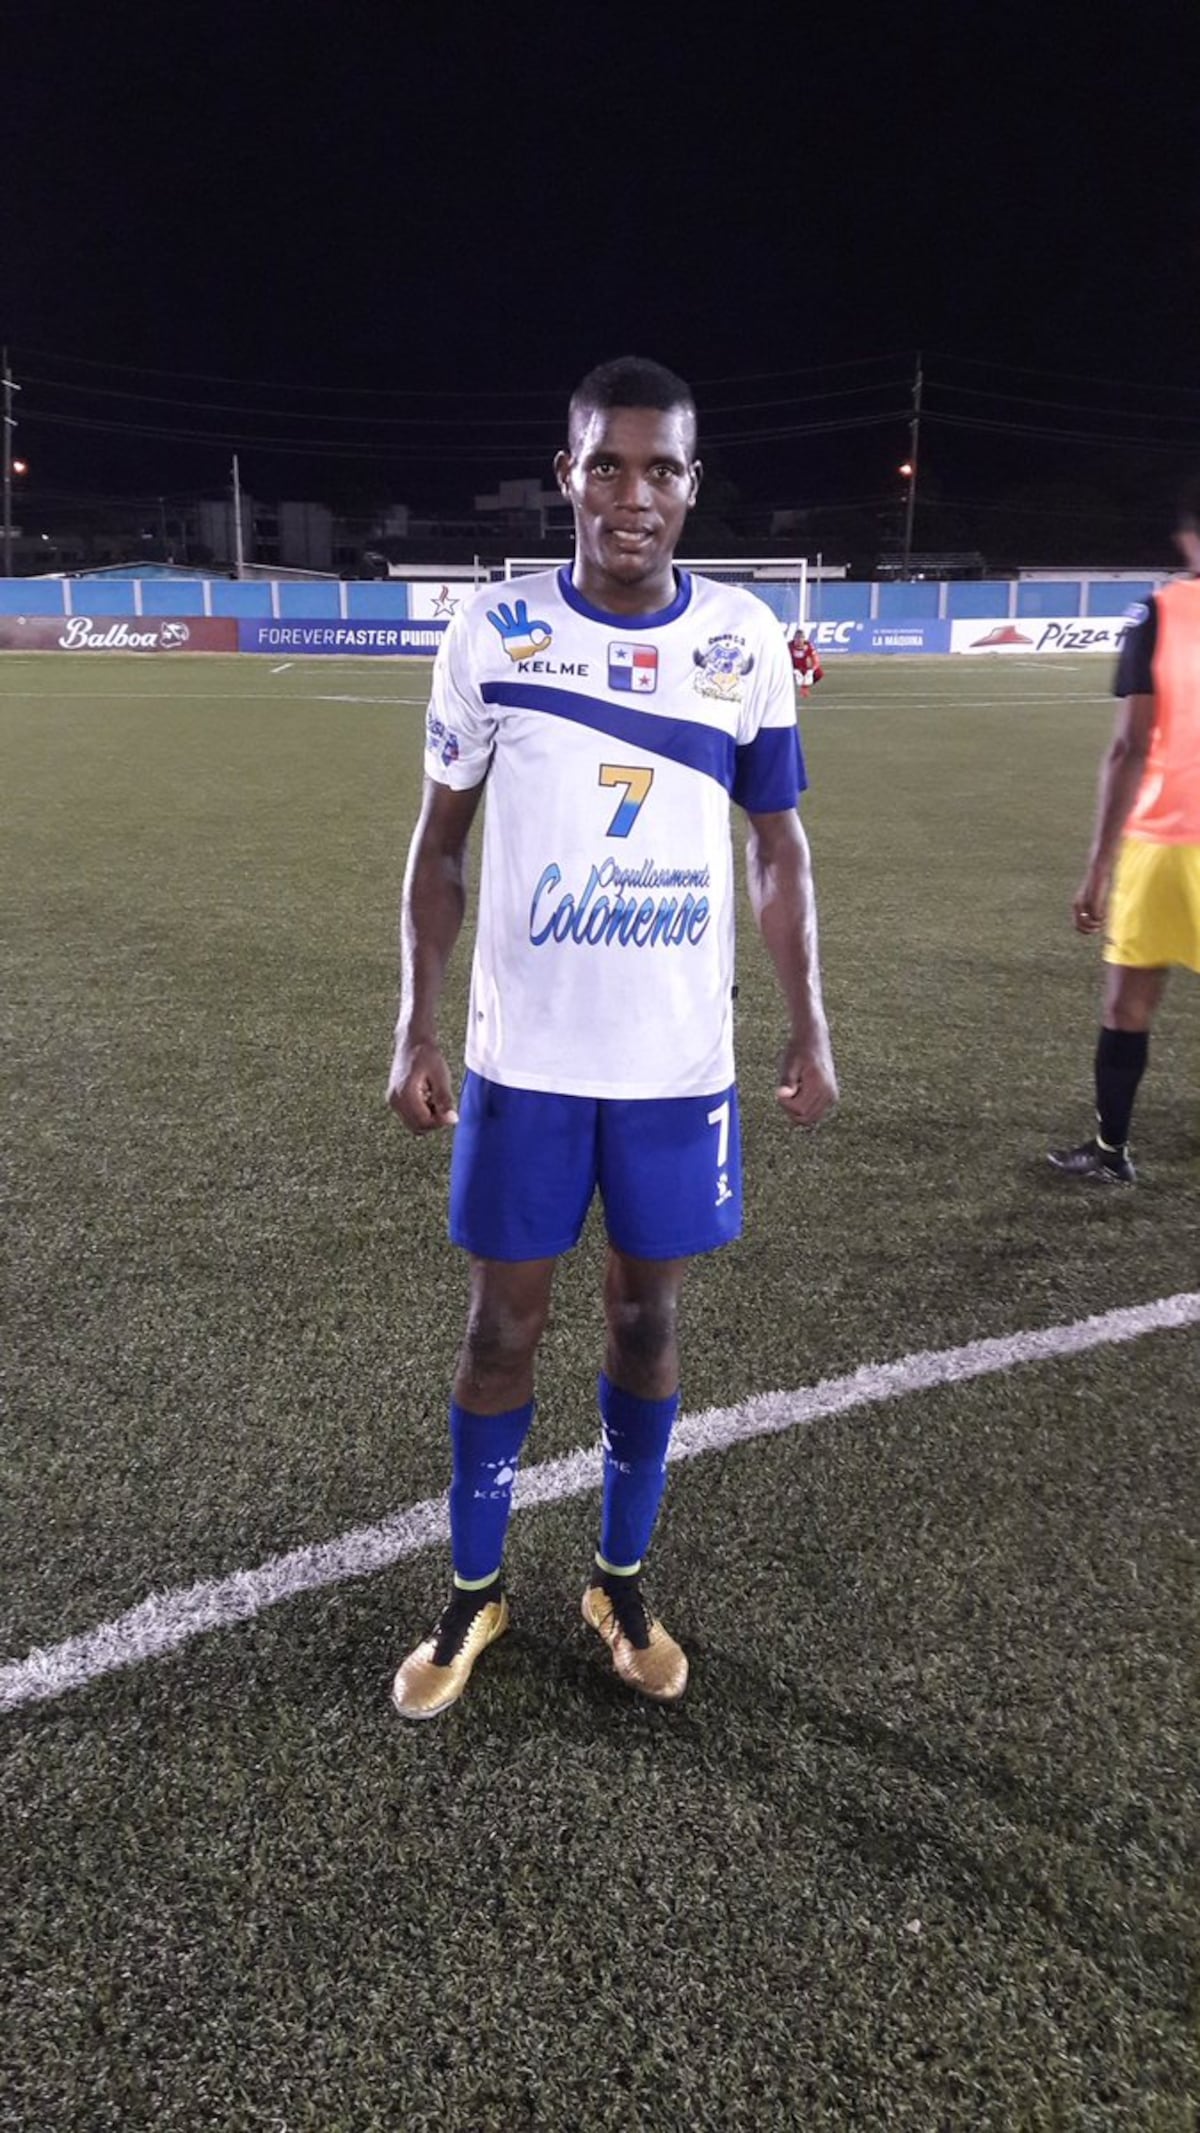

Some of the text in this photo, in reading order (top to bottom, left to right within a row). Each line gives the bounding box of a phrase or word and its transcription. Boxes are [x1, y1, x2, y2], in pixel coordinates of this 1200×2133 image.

[59, 616, 158, 649] Balboa
[1036, 622, 1110, 650] Pizza
[517, 660, 589, 676] KELME
[598, 763, 654, 837] 7
[529, 862, 711, 947] Colonense
